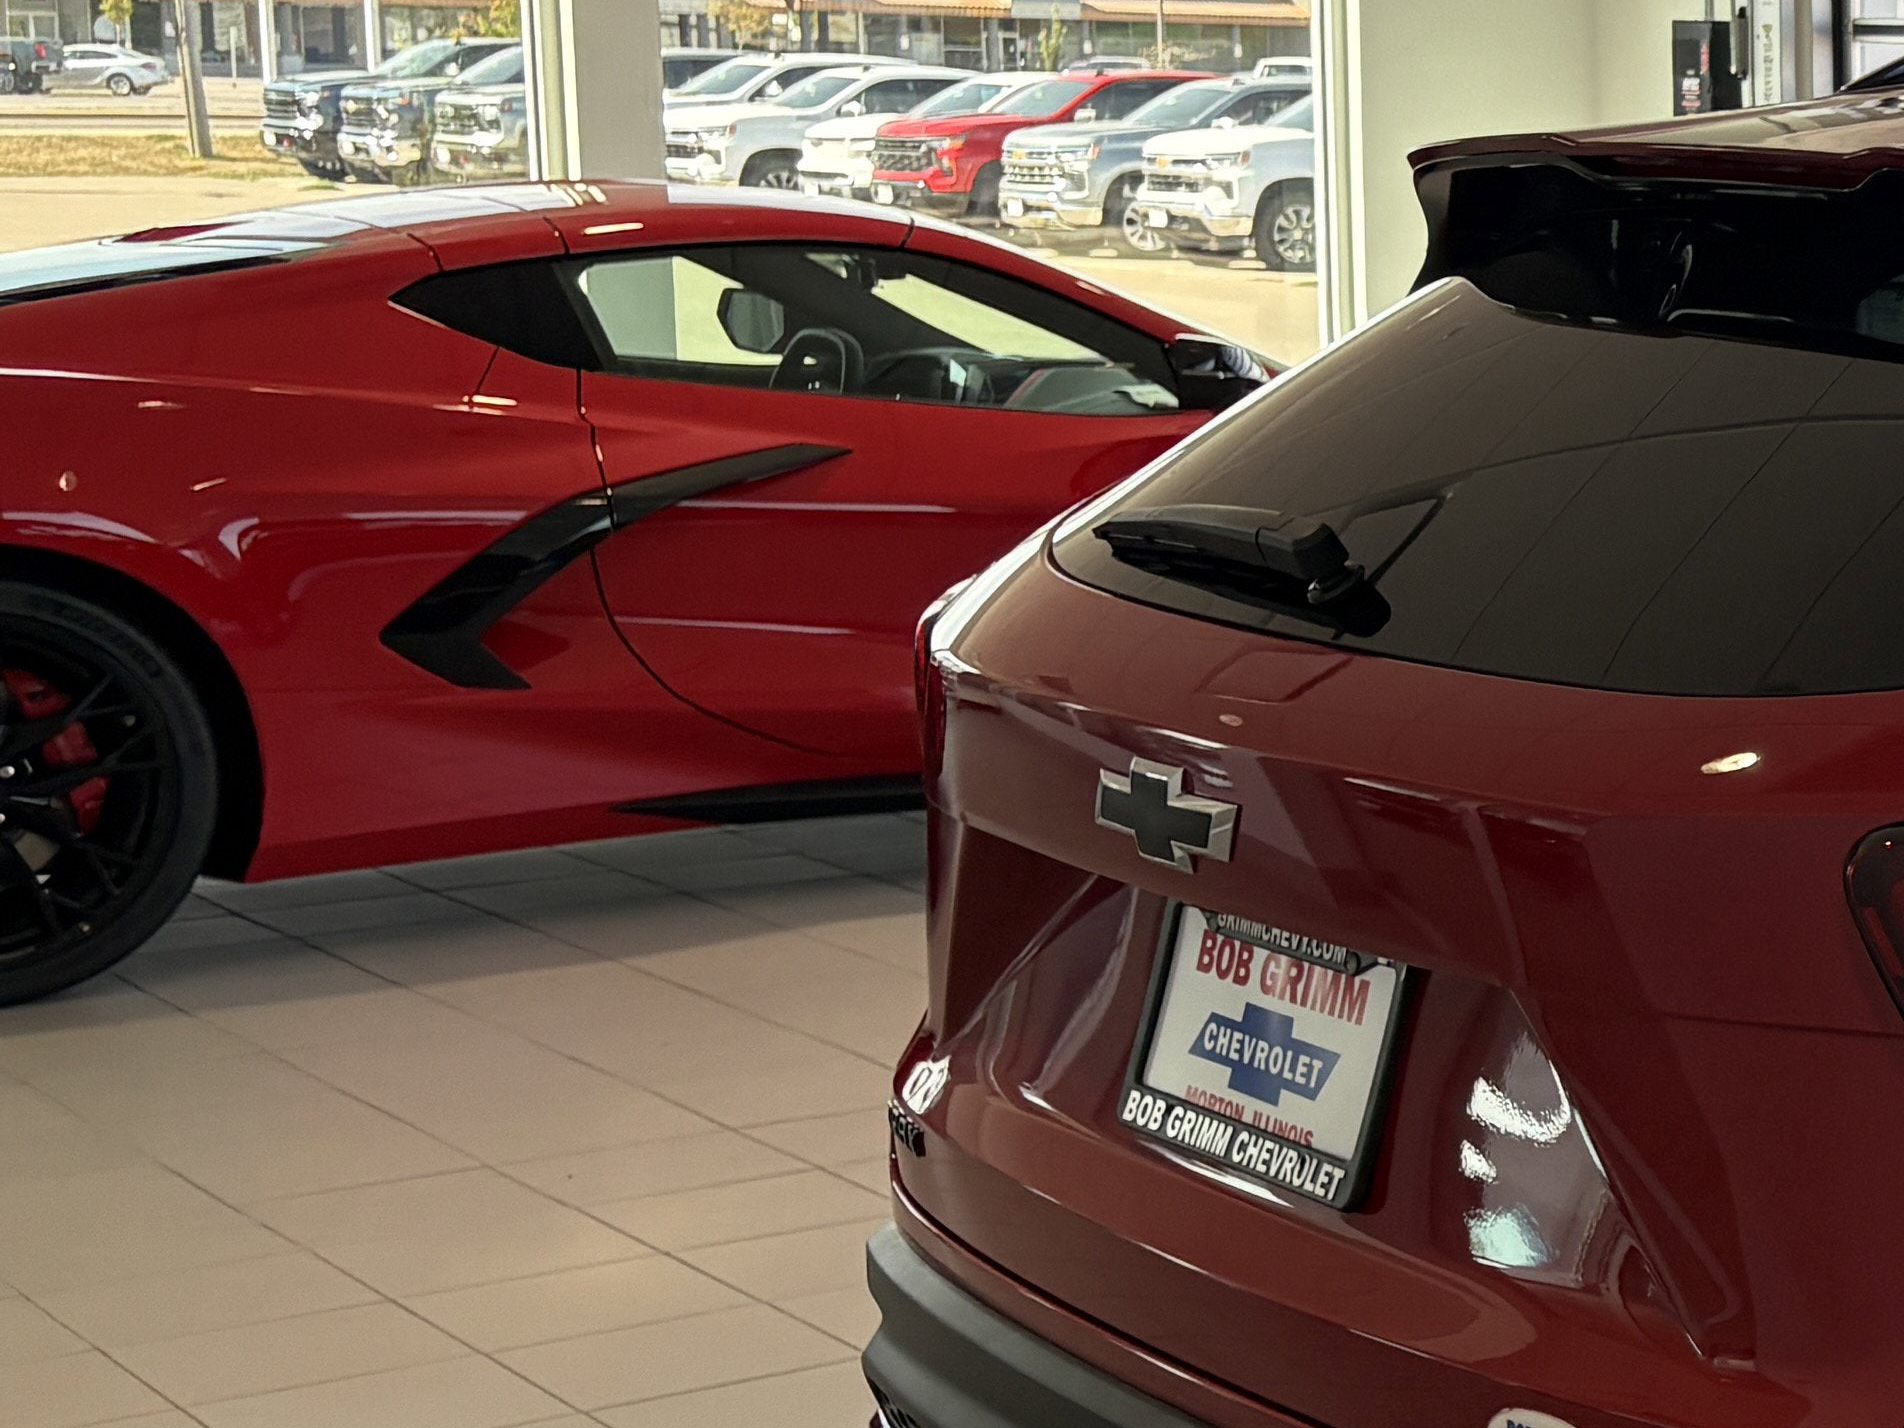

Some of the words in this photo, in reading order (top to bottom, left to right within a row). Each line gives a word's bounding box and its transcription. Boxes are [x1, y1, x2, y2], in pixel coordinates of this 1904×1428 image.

[1217, 913, 1347, 965] GRIMMCHEVY.COM
[1196, 928, 1255, 987] BOB
[1259, 951, 1371, 1026] GRIMM
[1203, 1022, 1324, 1089] CHEVROLET
[1121, 1089, 1168, 1132] BOB
[1165, 1105, 1235, 1159] GRIMM
[1230, 1130, 1346, 1202] CHEVROLET
[1252, 1109, 1315, 1148] ILLINOIS
